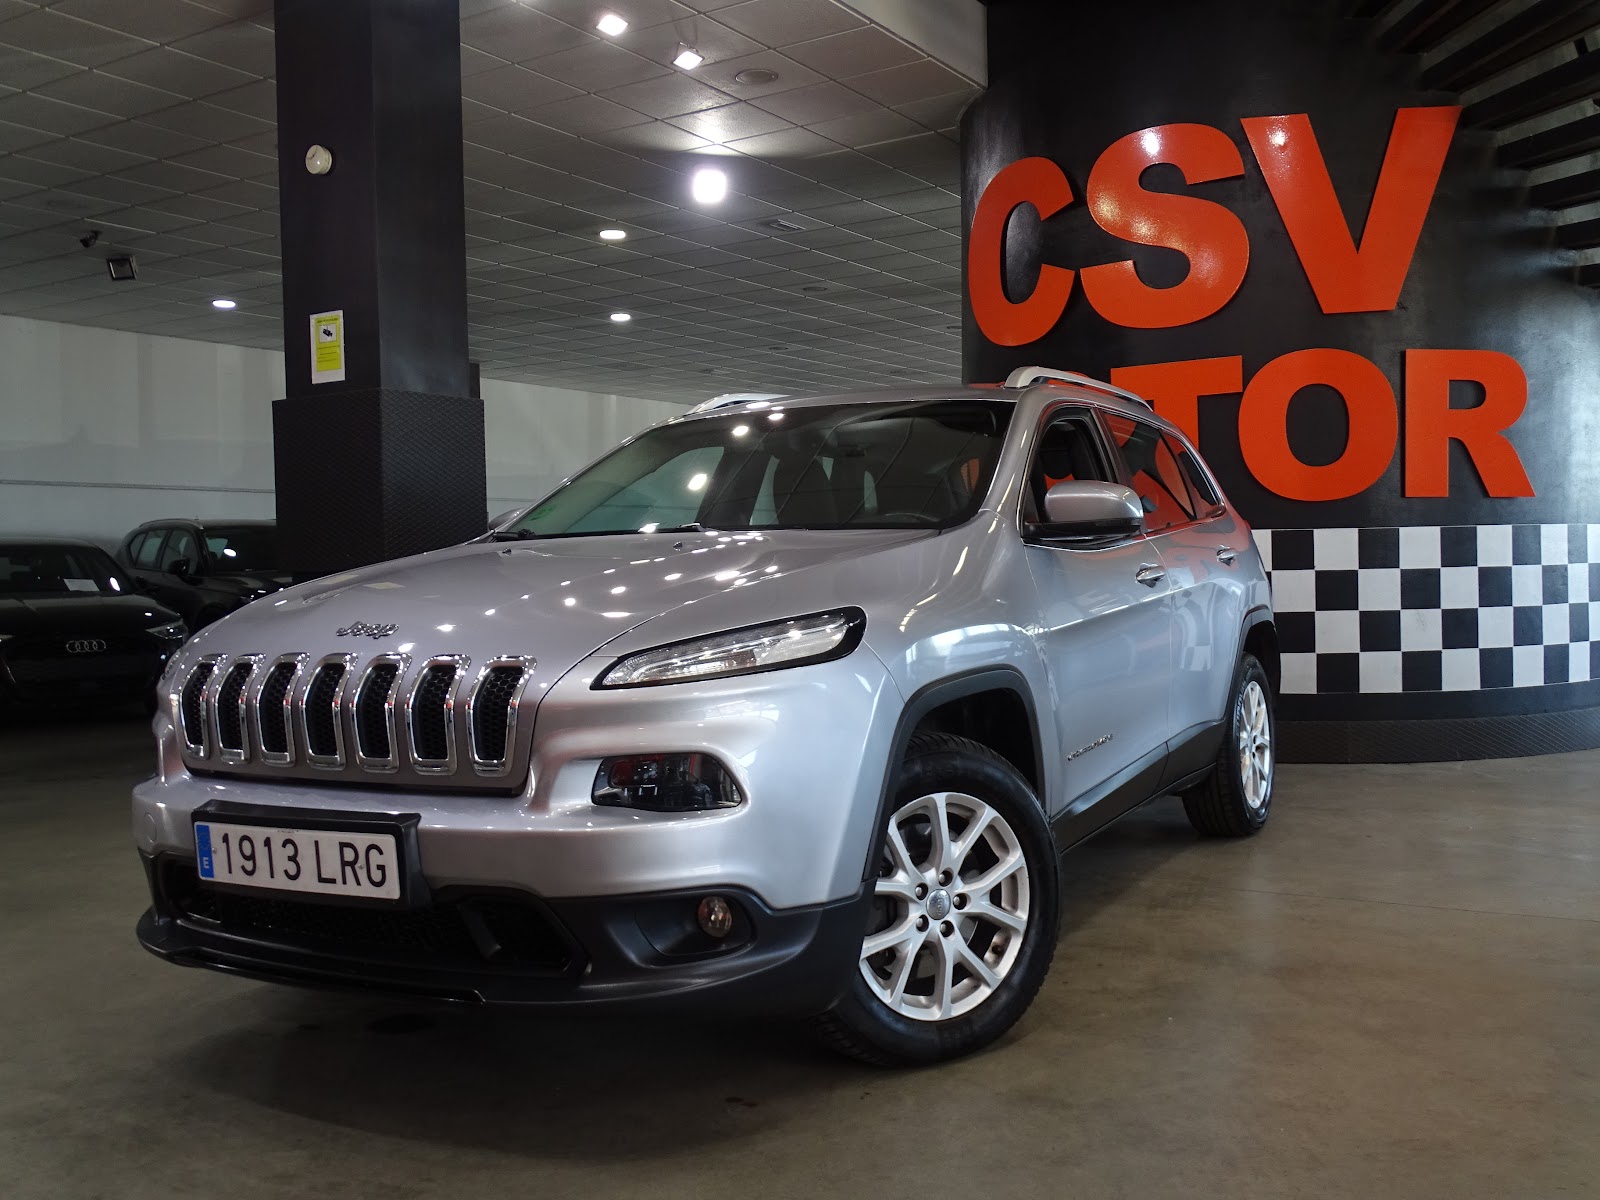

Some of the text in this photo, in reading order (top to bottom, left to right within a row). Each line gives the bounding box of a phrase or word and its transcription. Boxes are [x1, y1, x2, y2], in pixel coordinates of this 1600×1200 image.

[969, 106, 1463, 346] CSV
[968, 348, 1535, 501] TOR
[336, 621, 399, 639] Jeep
[203, 856, 210, 869] E
[222, 833, 387, 888] 1913 LRG
